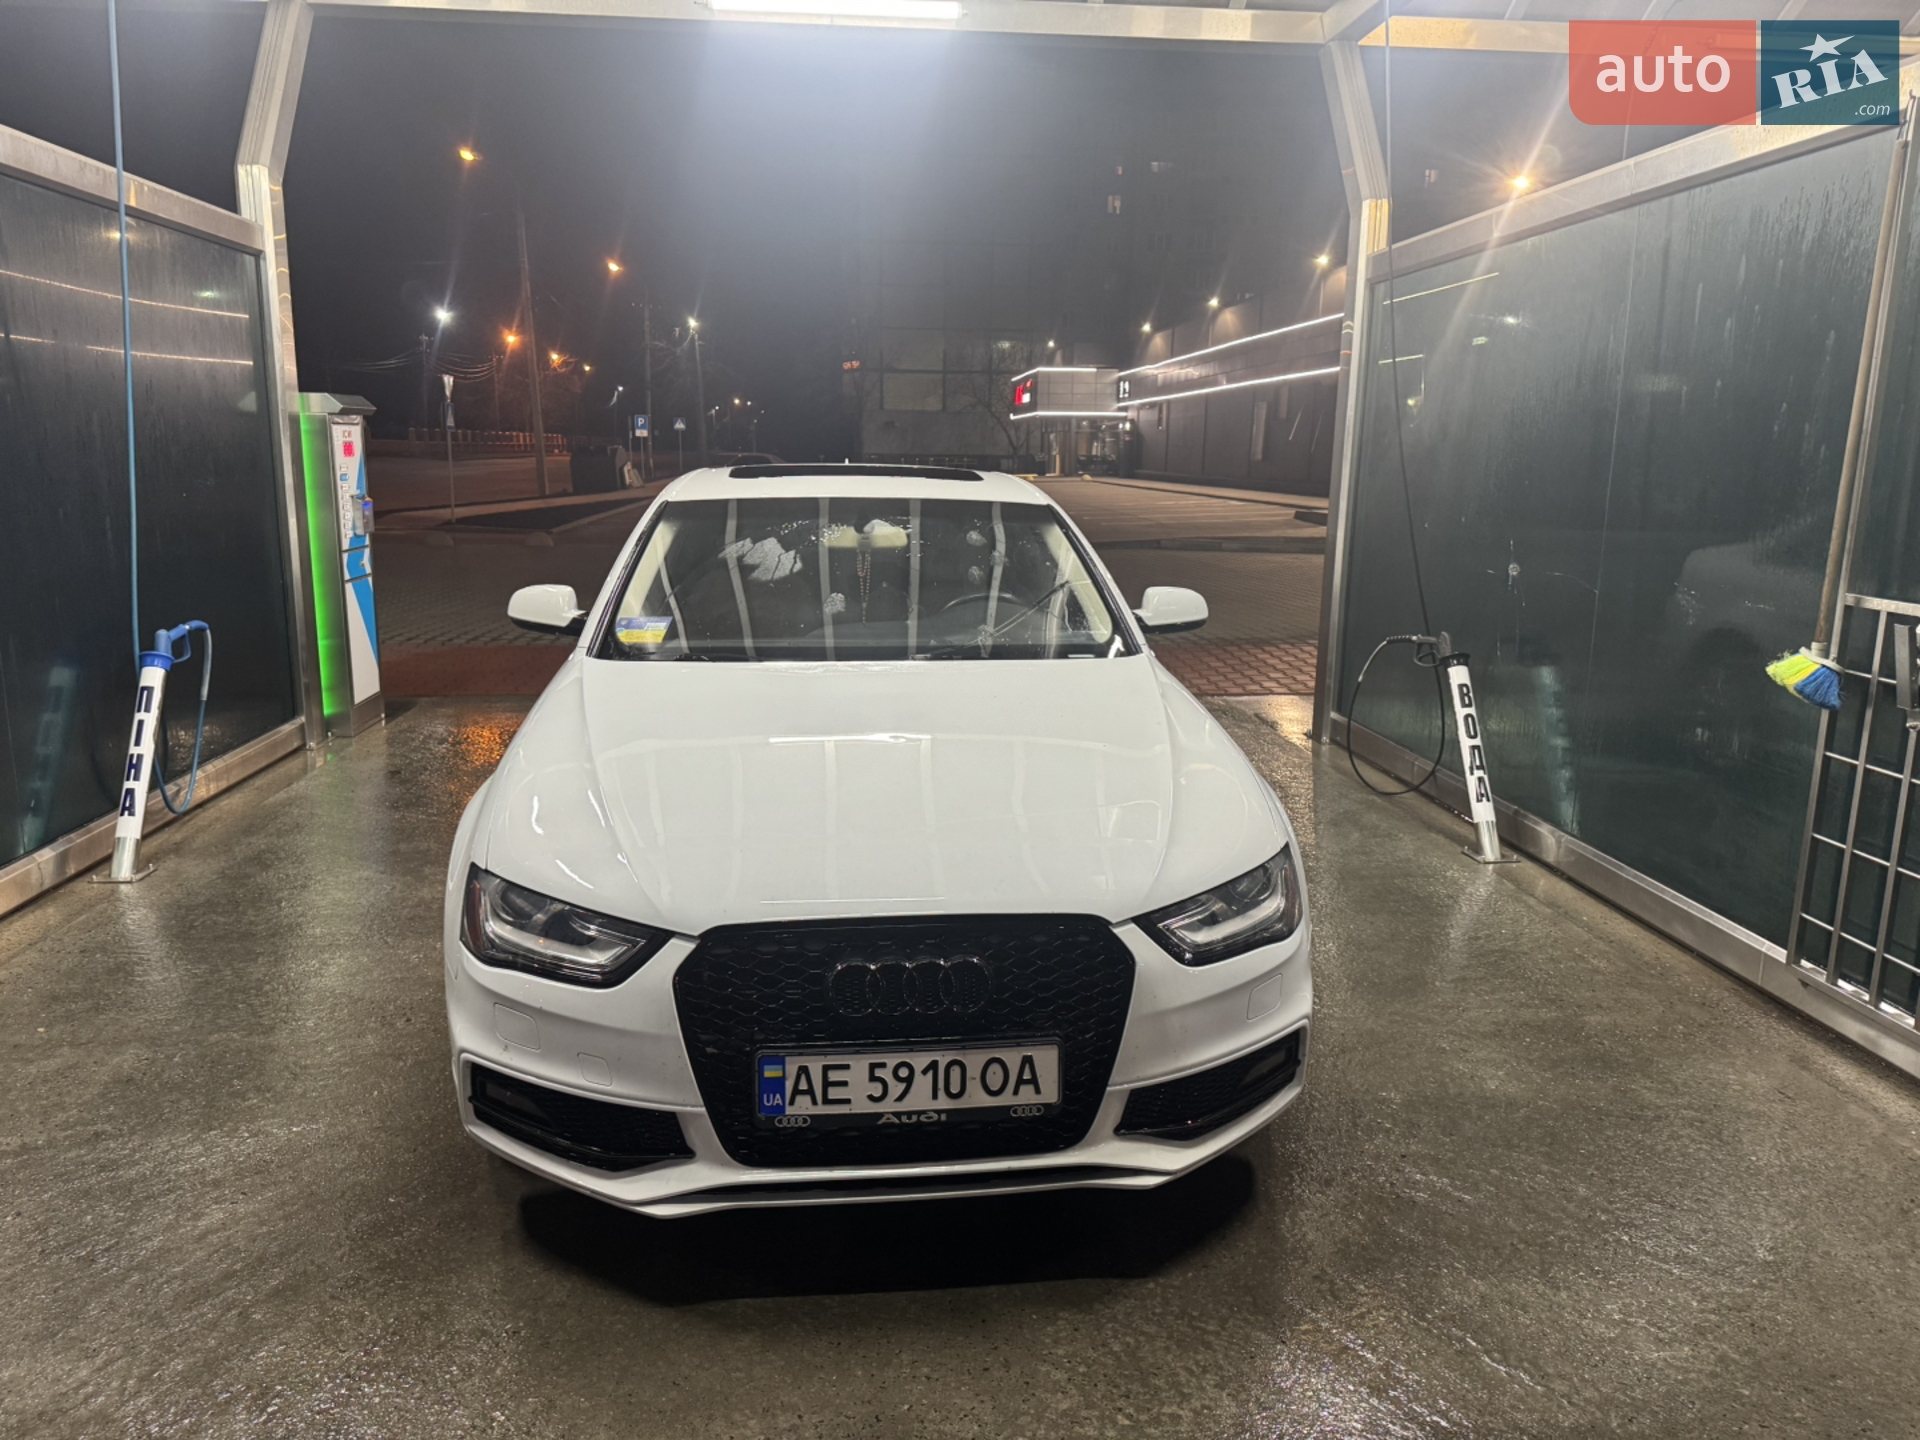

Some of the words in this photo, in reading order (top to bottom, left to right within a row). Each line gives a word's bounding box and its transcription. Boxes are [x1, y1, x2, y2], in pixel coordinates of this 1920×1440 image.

[637, 416, 646, 428] P
[119, 686, 155, 817] ПІНА
[1457, 683, 1491, 803] ВОДА
[787, 1063, 852, 1107] AE
[865, 1058, 968, 1103] 5910
[980, 1053, 1042, 1097] OA
[763, 1093, 784, 1107] UA
[876, 1111, 947, 1126] Audi
